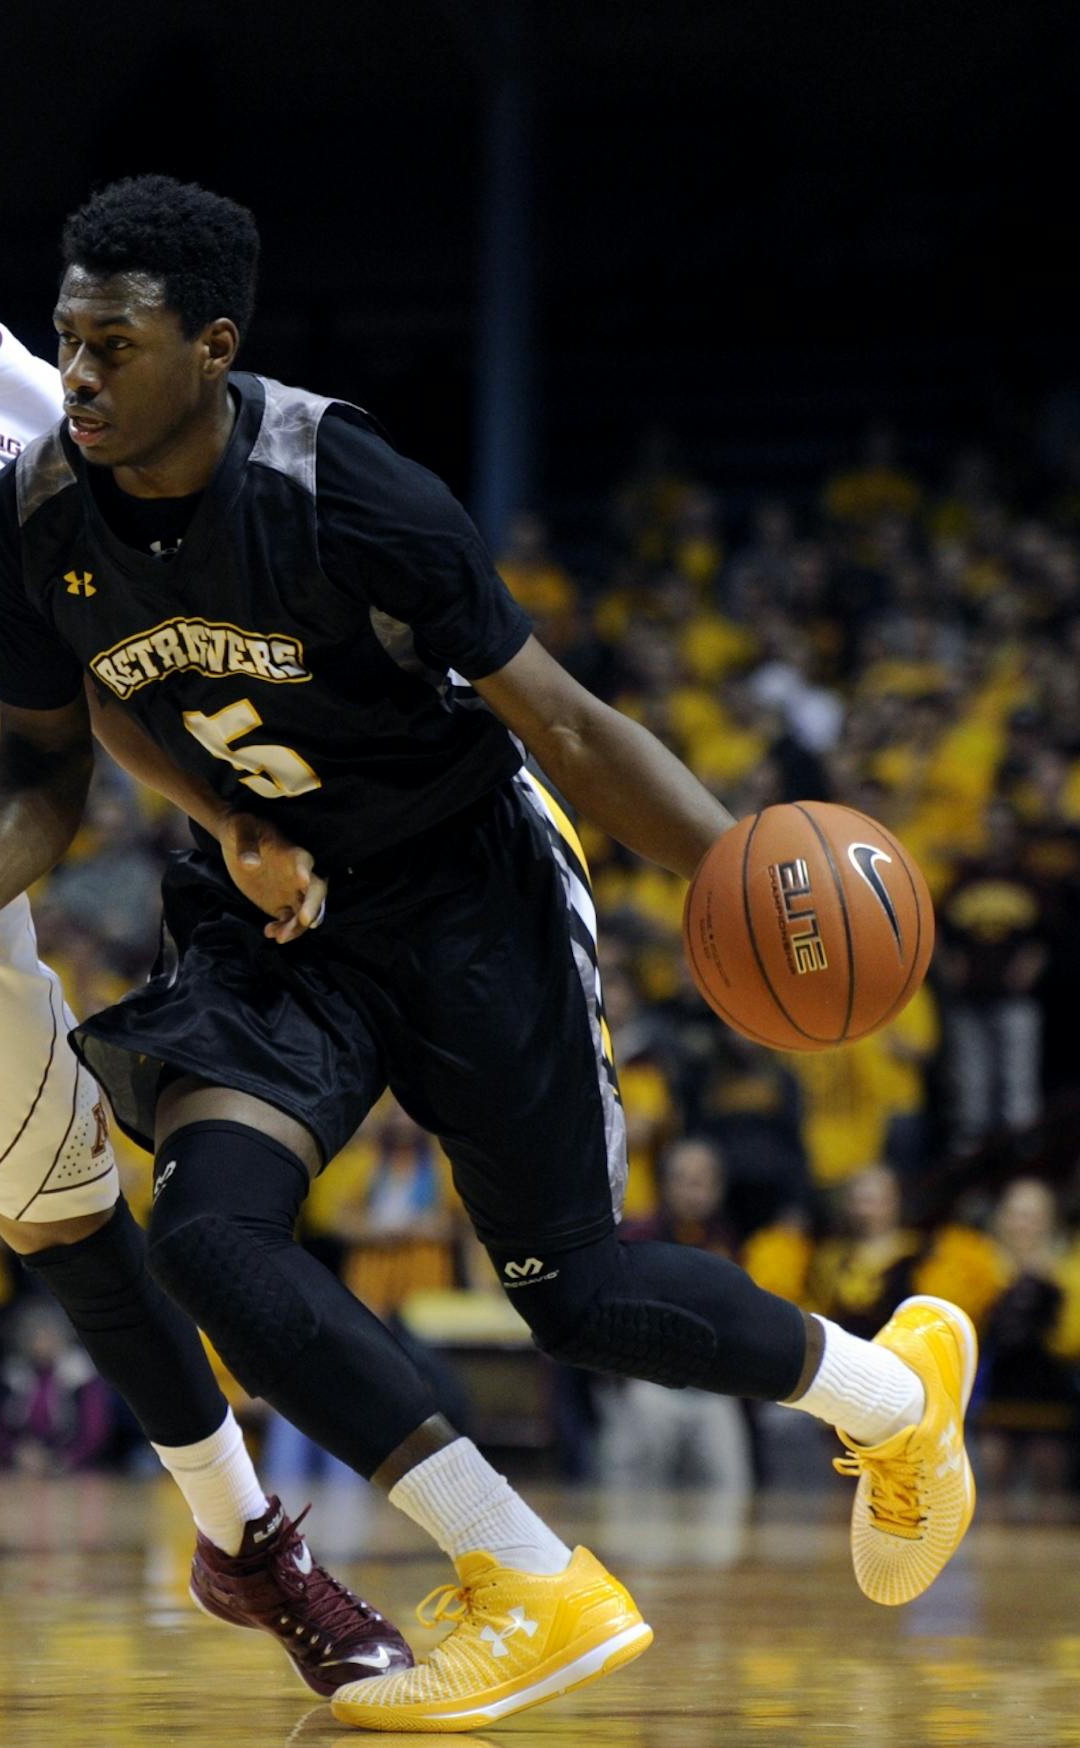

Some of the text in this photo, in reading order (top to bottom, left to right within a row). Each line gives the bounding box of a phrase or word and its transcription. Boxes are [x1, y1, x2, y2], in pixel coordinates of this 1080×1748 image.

[90, 616, 313, 699] RETRIEVERS
[182, 697, 322, 799] 5
[776, 858, 829, 975] ELITE
